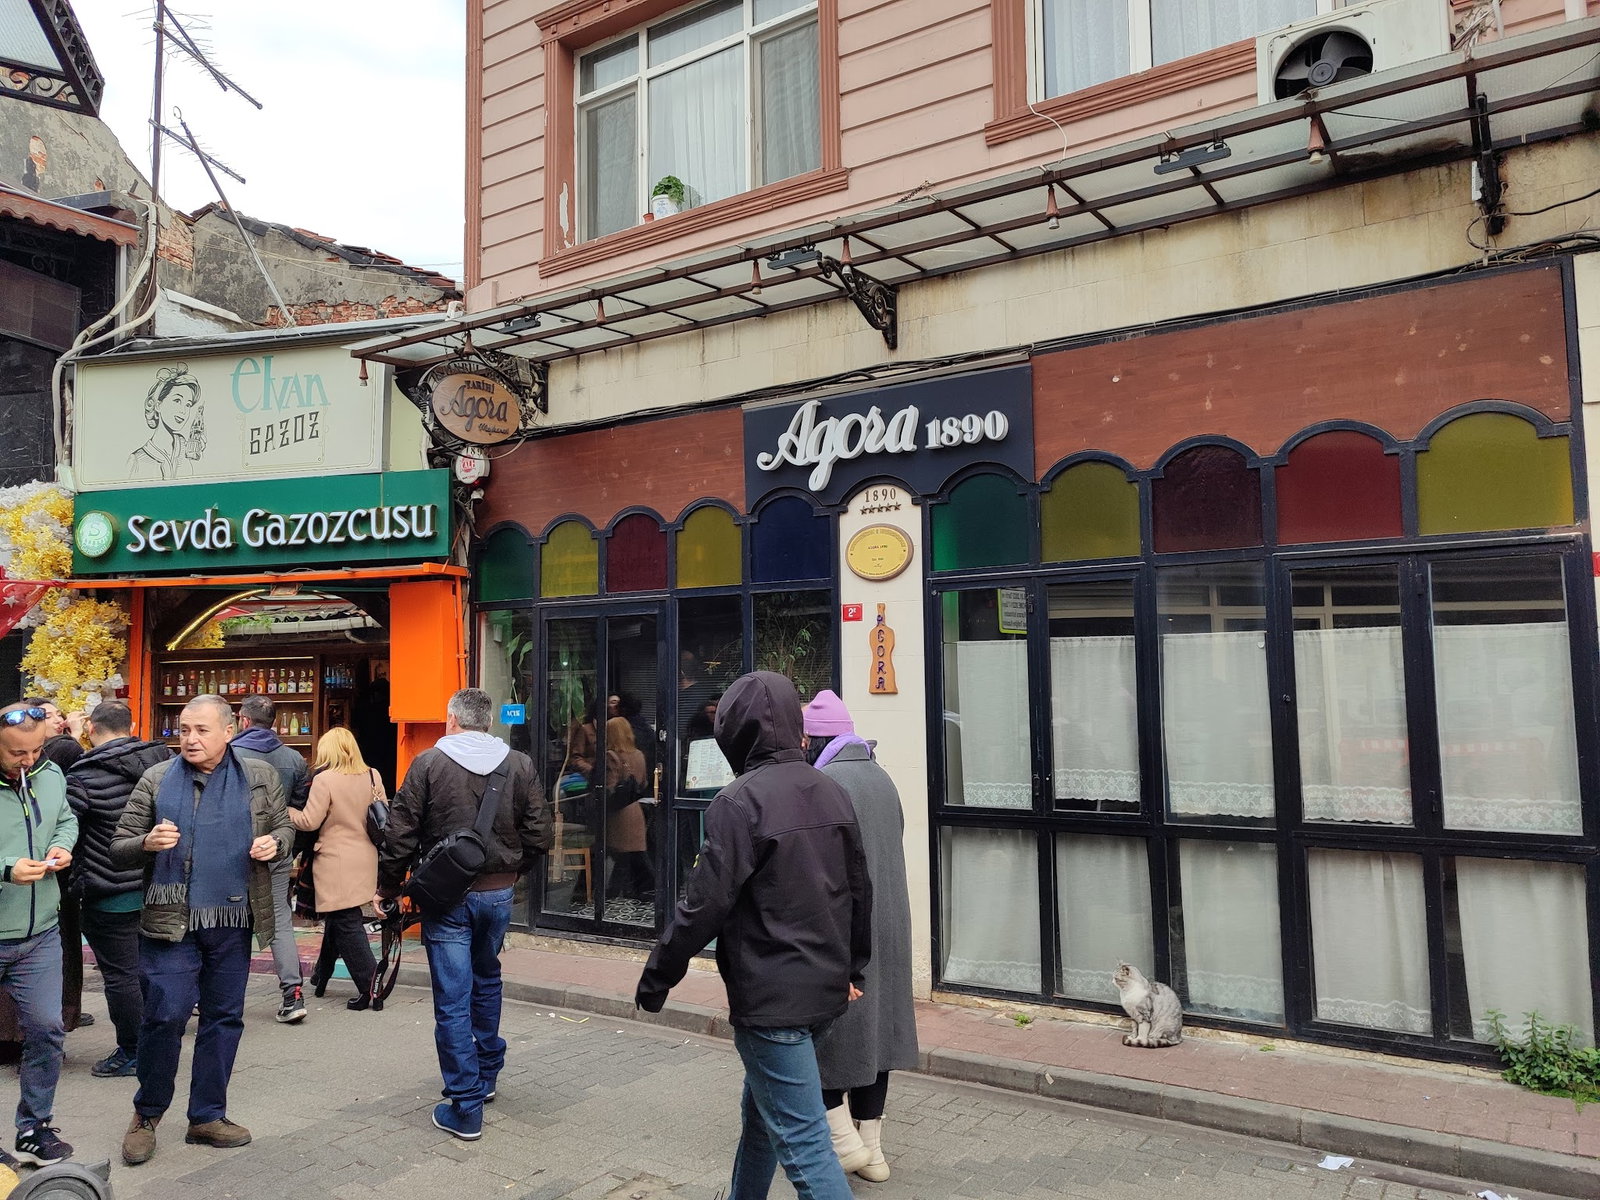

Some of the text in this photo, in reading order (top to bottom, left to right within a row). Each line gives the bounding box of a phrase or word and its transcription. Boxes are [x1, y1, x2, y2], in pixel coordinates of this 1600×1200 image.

[440, 385, 508, 431] Agora
[250, 411, 319, 455] GAZOZ
[757, 400, 1009, 491] Agora 1890
[865, 487, 897, 503] 1890
[126, 504, 436, 553] Sevda Gazozcusu
[875, 614, 887, 691] AGORA
